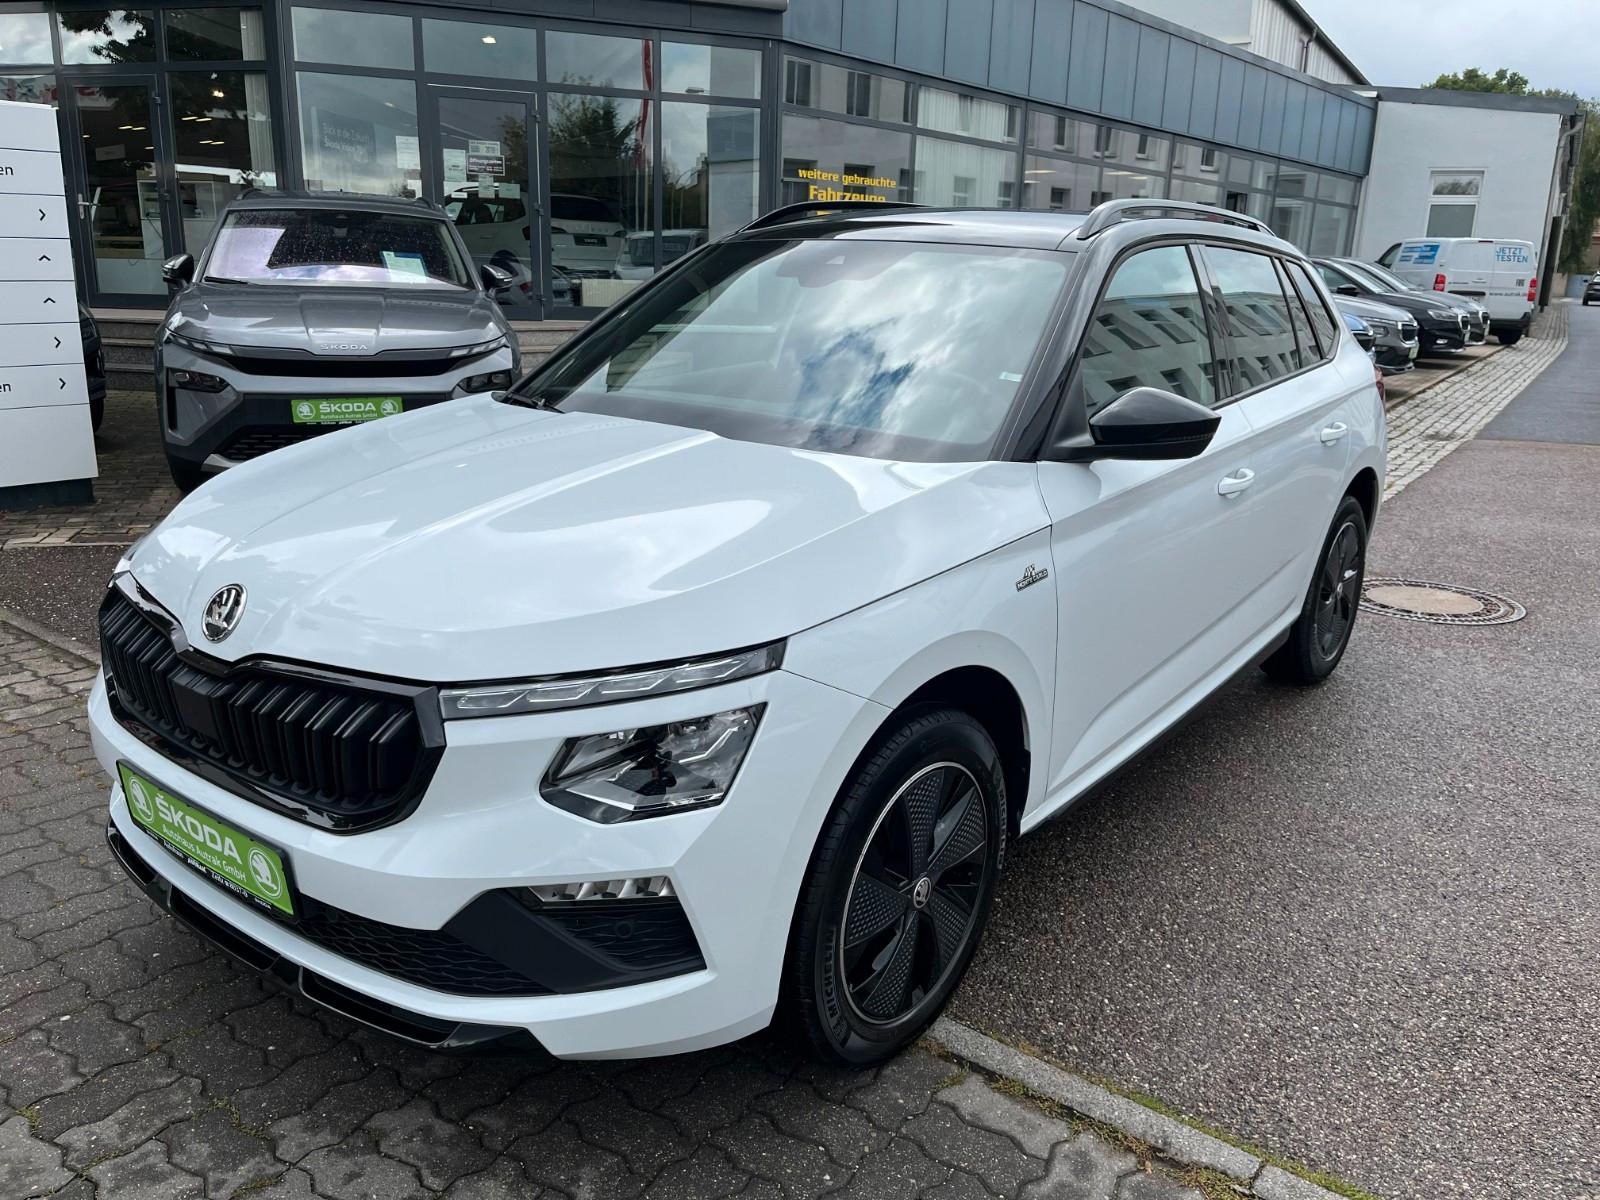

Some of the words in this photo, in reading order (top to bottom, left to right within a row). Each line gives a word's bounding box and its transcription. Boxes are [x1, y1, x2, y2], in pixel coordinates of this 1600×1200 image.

[798, 168, 839, 182] weitere
[842, 174, 897, 189] gebrauchte
[1496, 247, 1523, 255] JETZT
[1496, 255, 1529, 263] TESTEN
[319, 402, 377, 413] ŠKODA
[155, 793, 243, 865] ŠKODA
[162, 824, 195, 853] Autohaus
[196, 845, 222, 868] Autrak
[222, 861, 247, 883] GmbH
[822, 930, 840, 1018] MICHELIN
